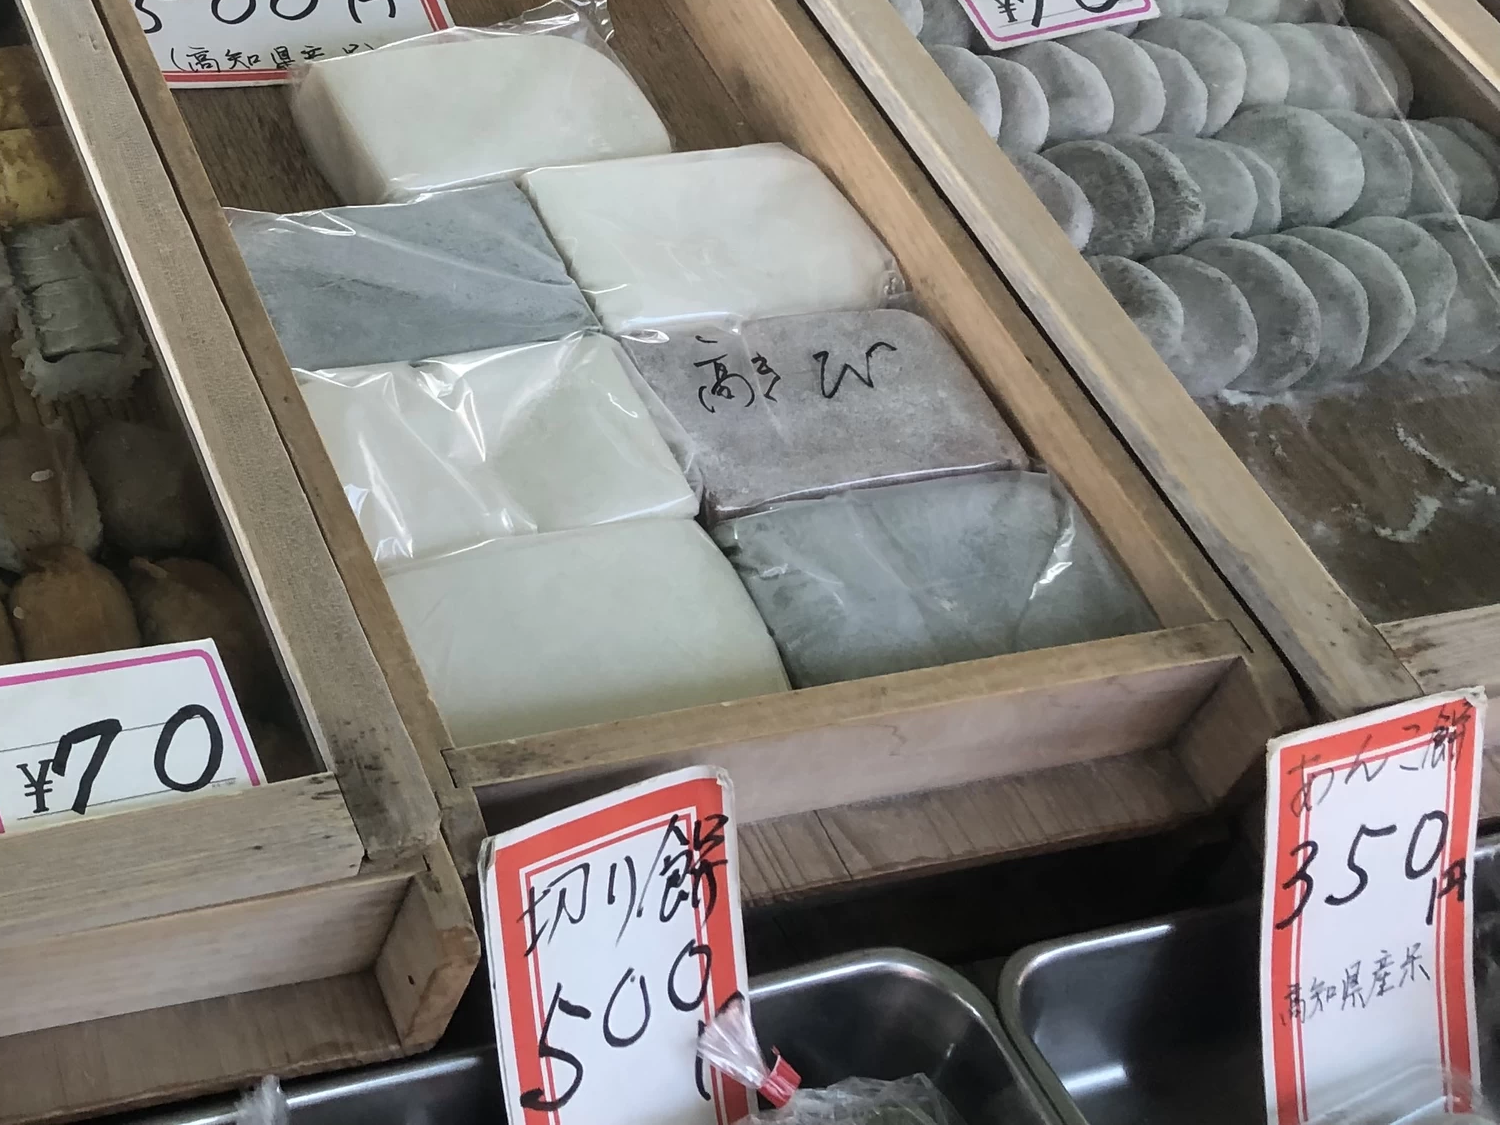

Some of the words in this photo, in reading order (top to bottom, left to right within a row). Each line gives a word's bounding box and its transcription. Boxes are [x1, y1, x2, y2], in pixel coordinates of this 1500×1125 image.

[16, 703, 224, 815] ¥70
[516, 813, 729, 957] 切り餅
[1275, 809, 1467, 931] 350円
